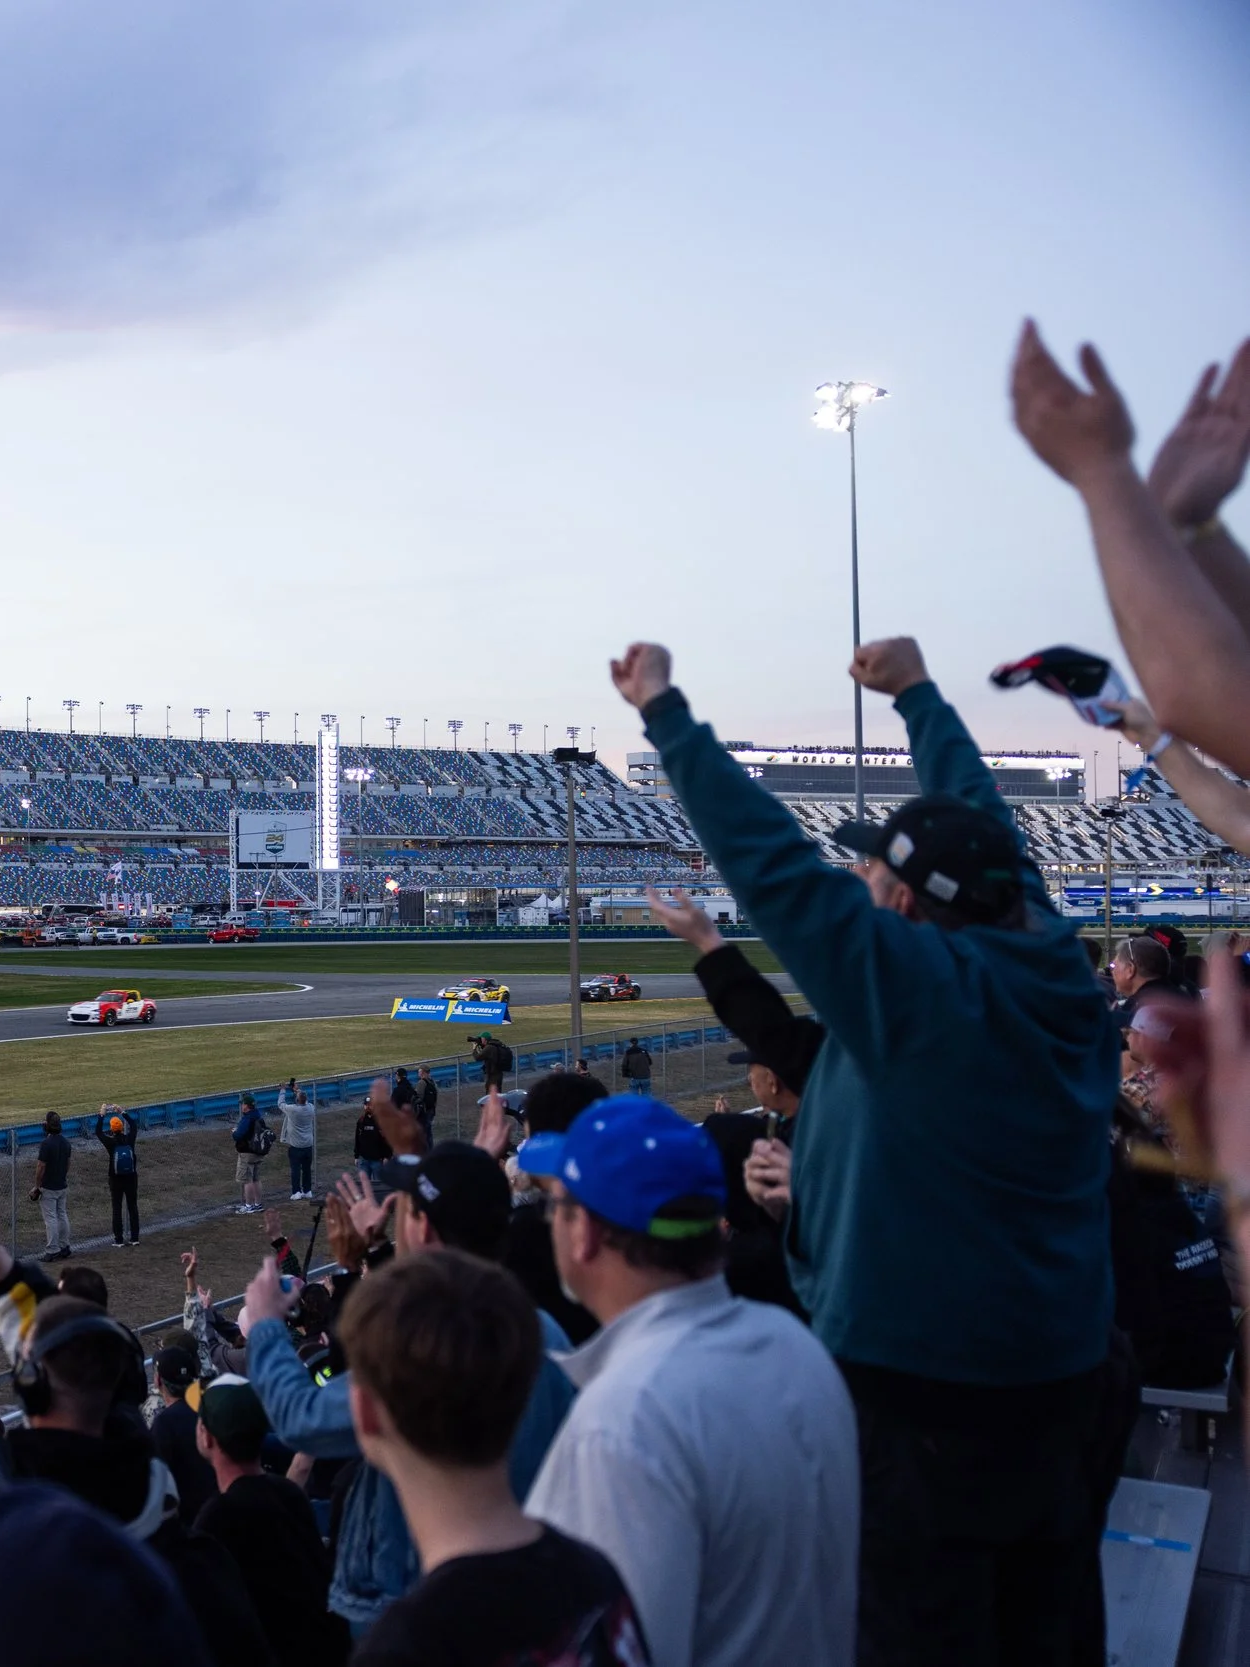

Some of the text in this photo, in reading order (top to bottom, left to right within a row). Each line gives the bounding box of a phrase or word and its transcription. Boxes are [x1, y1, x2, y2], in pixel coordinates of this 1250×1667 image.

[792, 755, 836, 764] WORLD
[845, 756, 896, 765] CNTER
[266, 833, 284, 842] 24
